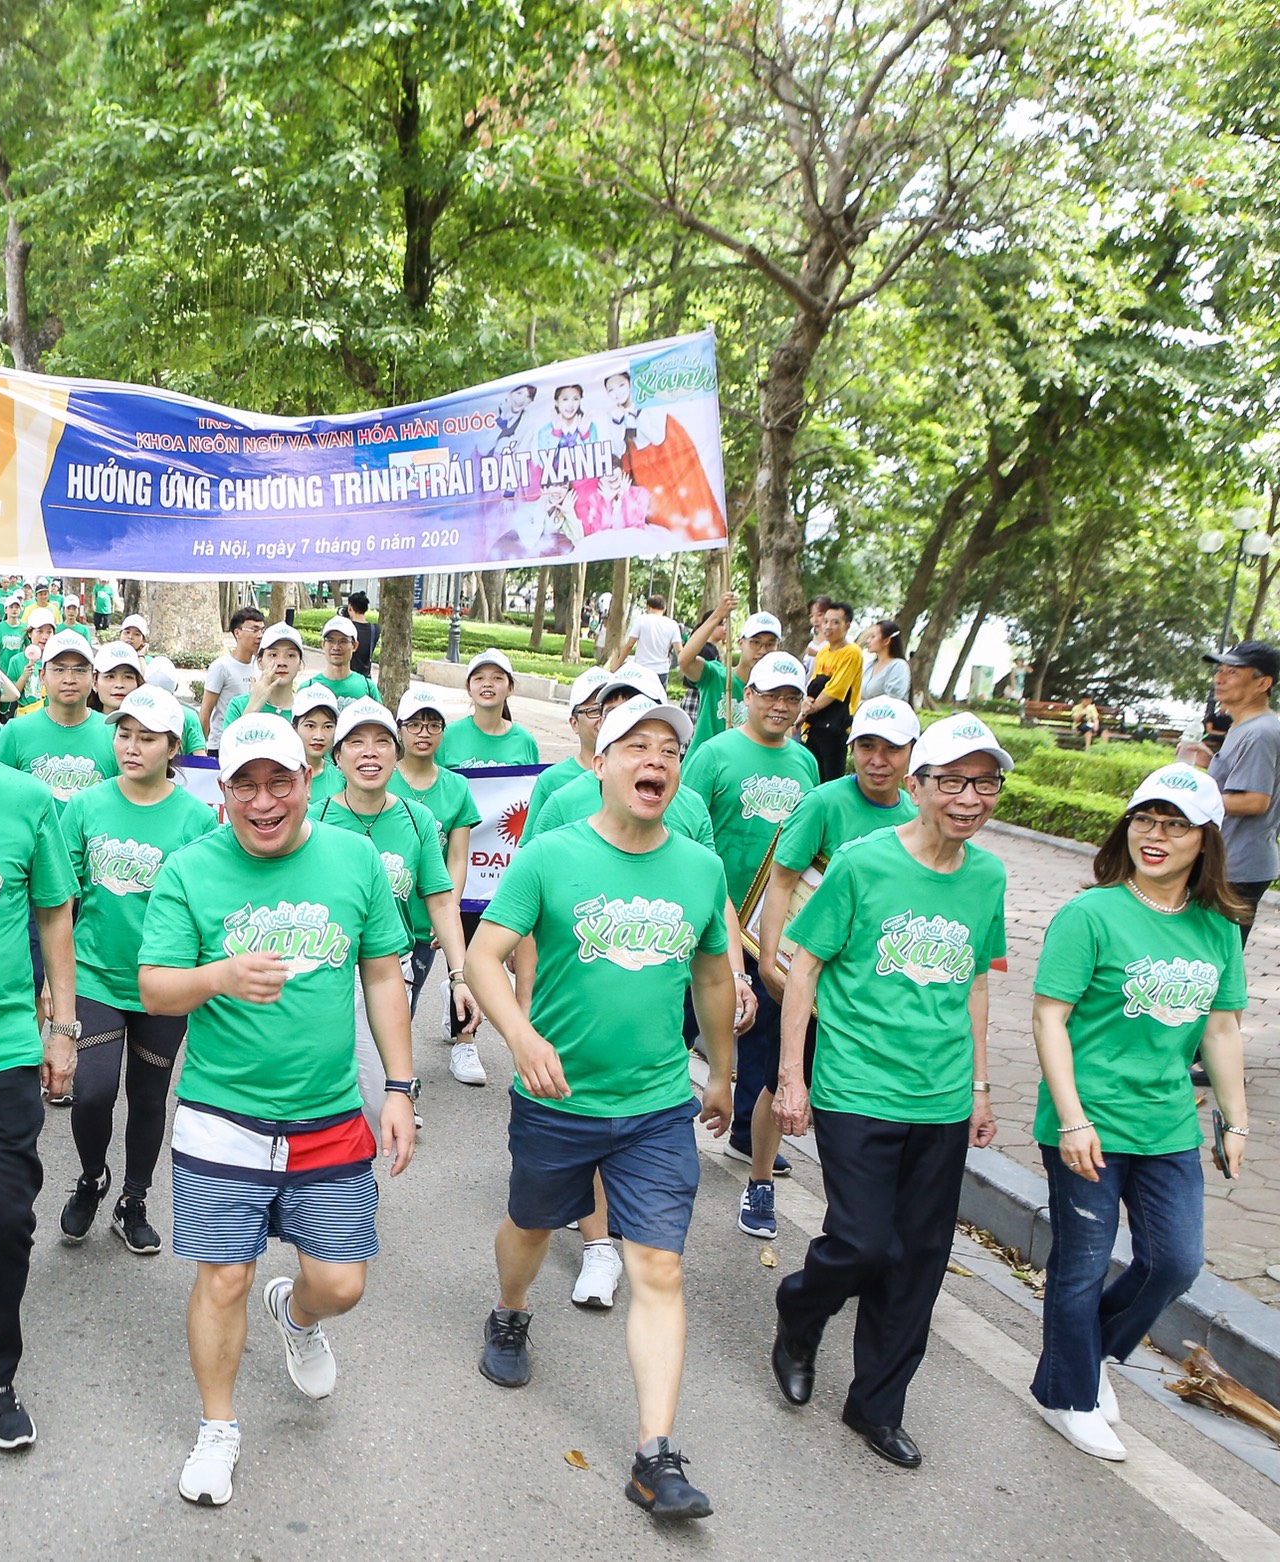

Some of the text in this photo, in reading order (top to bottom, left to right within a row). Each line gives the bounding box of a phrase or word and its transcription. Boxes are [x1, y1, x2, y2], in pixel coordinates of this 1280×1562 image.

[634, 366, 716, 403] Xanh
[136, 432, 185, 452] KHOA
[188, 432, 240, 453] NGÔN
[243, 433, 284, 454] NGỮ
[357, 423, 397, 446] HÓA
[400, 418, 440, 442] HÀN
[67, 441, 613, 512] HƯỞNG ỨNG CHƯƠNG TRÌNH TRÁI ĐẤT XANH
[192, 528, 460, 559] Hà Nội, ngày 7 tháng 6 năm 2020
[224, 923, 351, 966] Xanh
[574, 916, 697, 962] Xanh
[877, 932, 974, 983] Xanh
[1122, 976, 1217, 1017] Xan
